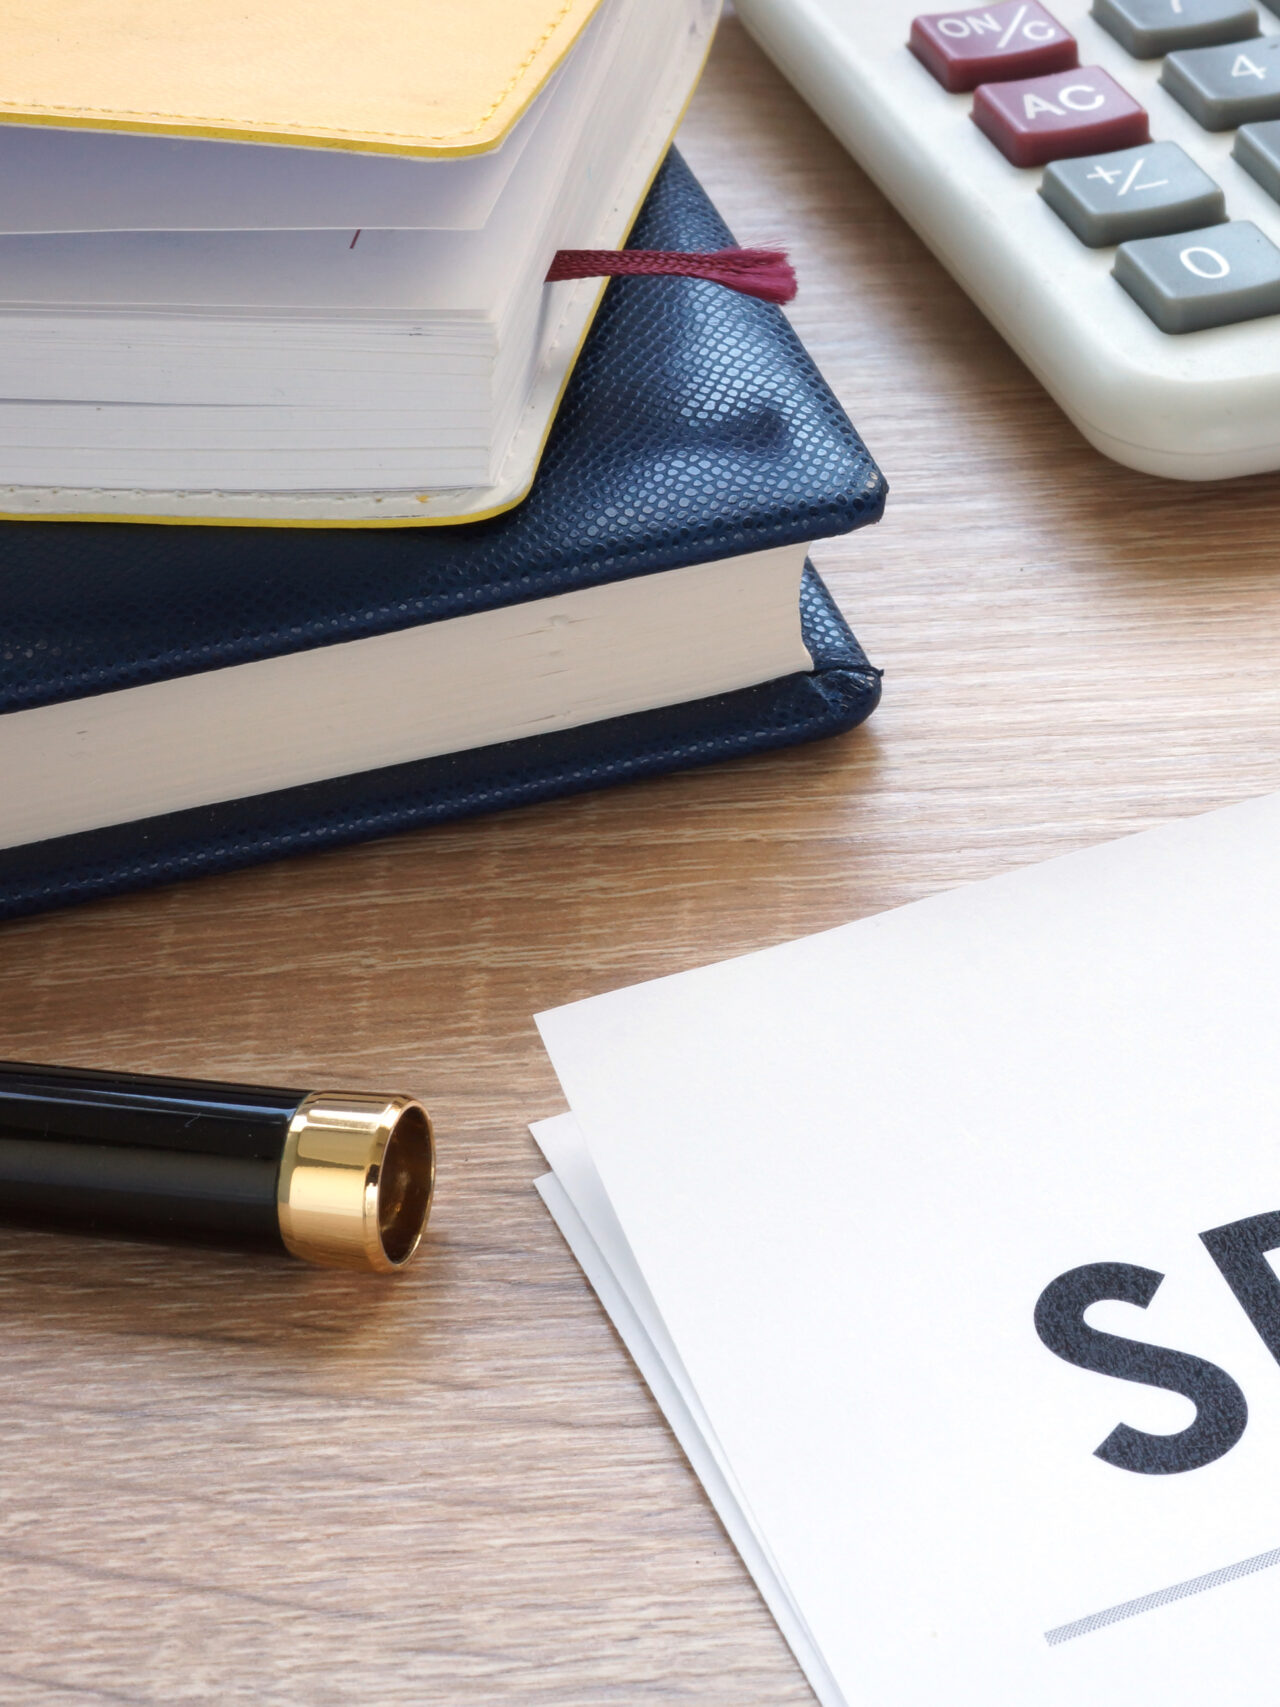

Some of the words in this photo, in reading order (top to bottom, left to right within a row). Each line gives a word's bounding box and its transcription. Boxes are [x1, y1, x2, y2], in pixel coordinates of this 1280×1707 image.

[936, 5, 1056, 48] ON/C
[1231, 55, 1266, 80] 4
[1023, 85, 1105, 119] AC
[1179, 246, 1231, 279] 0
